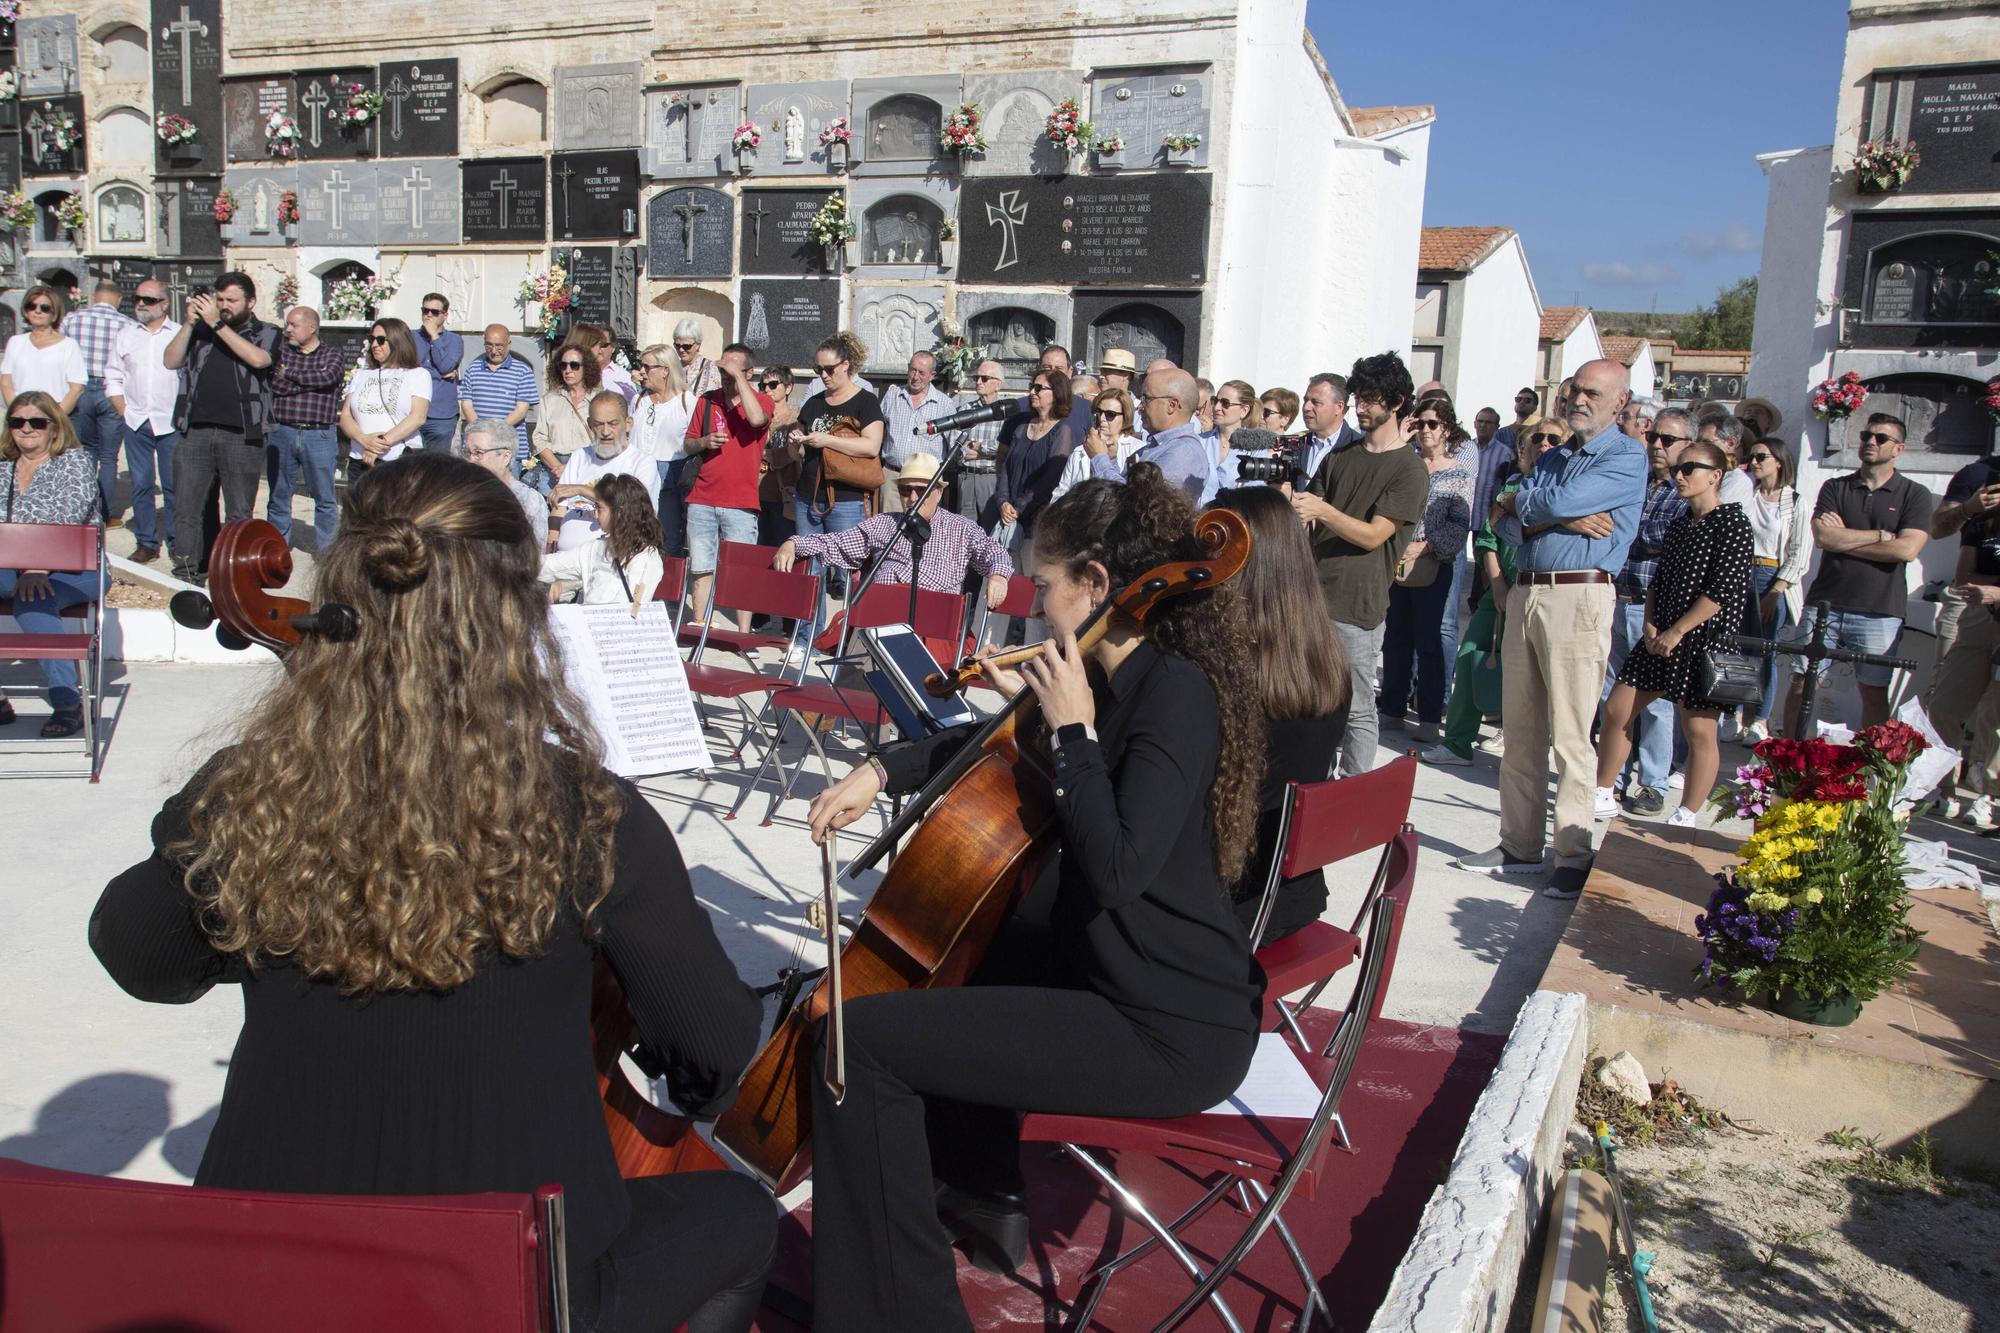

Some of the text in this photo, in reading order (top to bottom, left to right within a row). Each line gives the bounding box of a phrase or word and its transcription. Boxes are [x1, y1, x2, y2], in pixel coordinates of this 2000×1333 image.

[1948, 82, 1977, 91] MARIA
[1923, 95, 1952, 104] MOLLA
[796, 202, 817, 210] PEDRO
